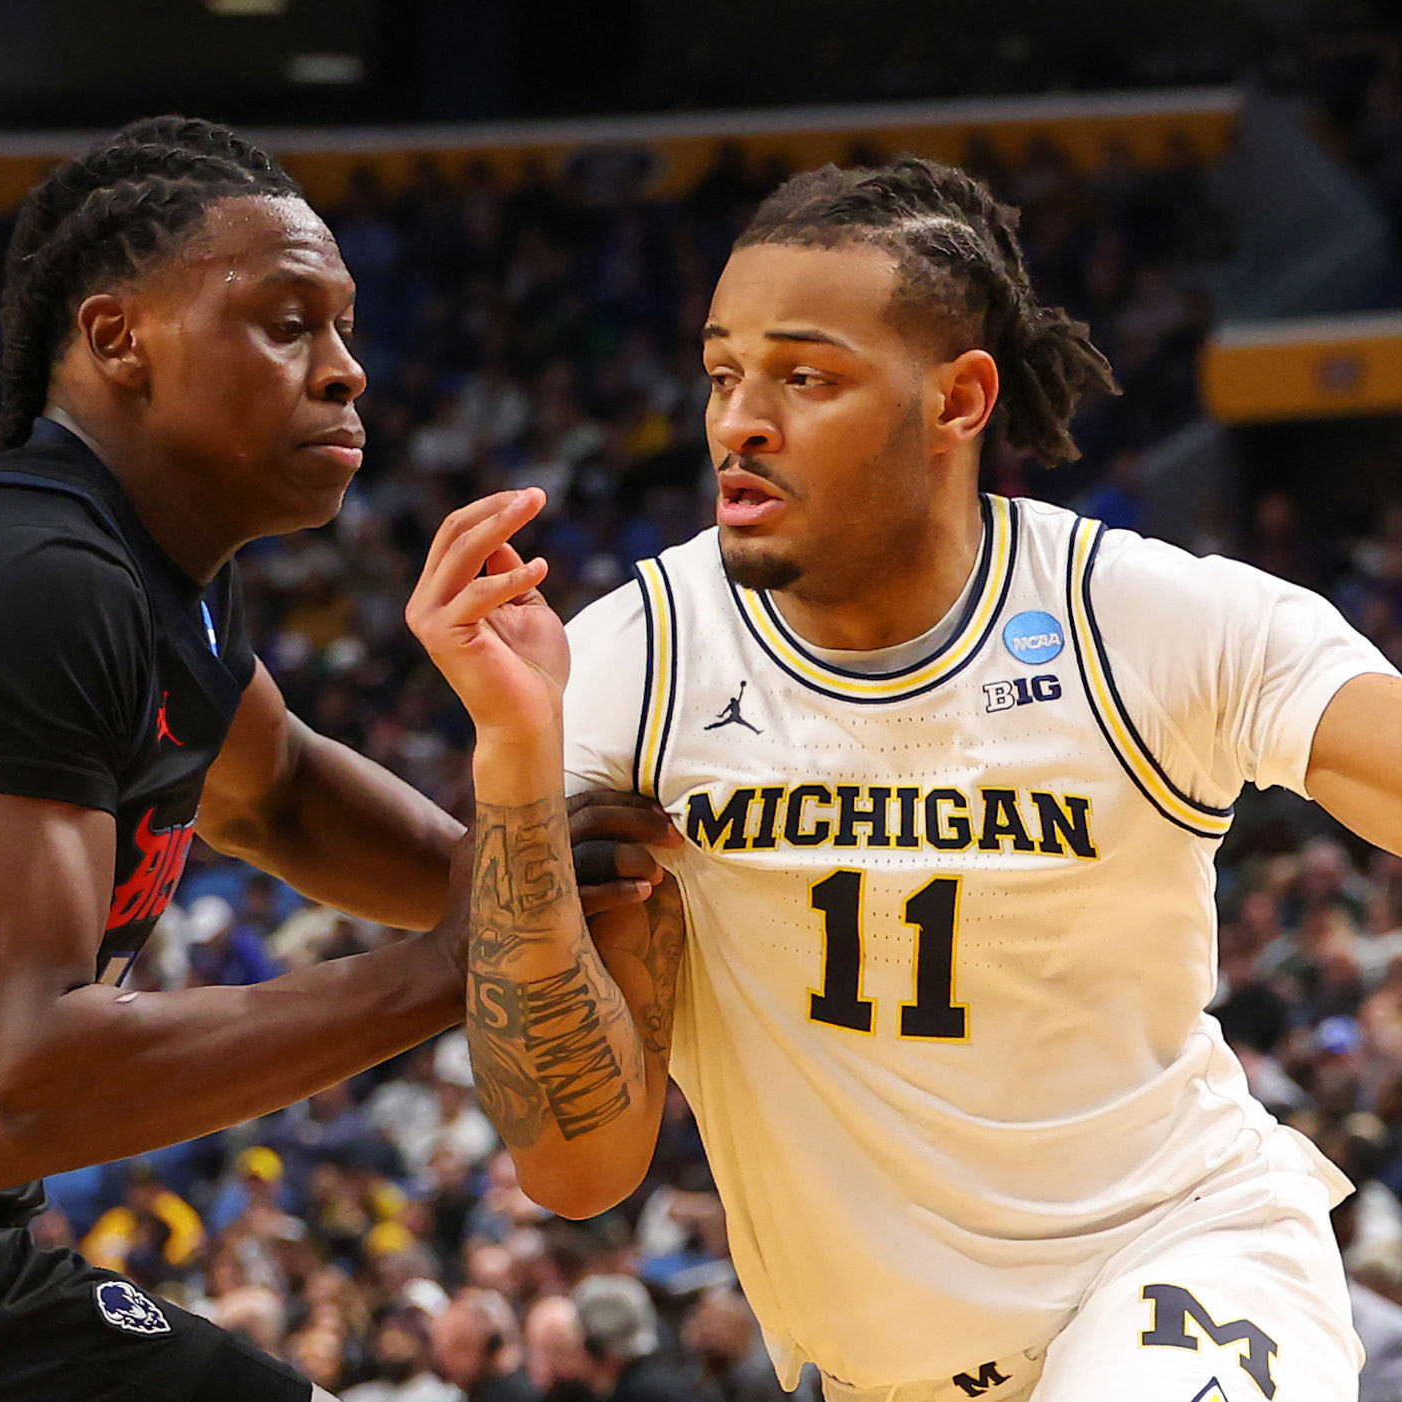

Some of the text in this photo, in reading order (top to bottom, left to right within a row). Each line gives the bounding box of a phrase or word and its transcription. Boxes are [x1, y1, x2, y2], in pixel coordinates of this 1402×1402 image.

[1013, 632, 1062, 651] NCAA
[685, 784, 1100, 861] MICHIGAN
[806, 868, 971, 1042] 11
[953, 1361, 1012, 1398] M
[1138, 1283, 1280, 1401] M
